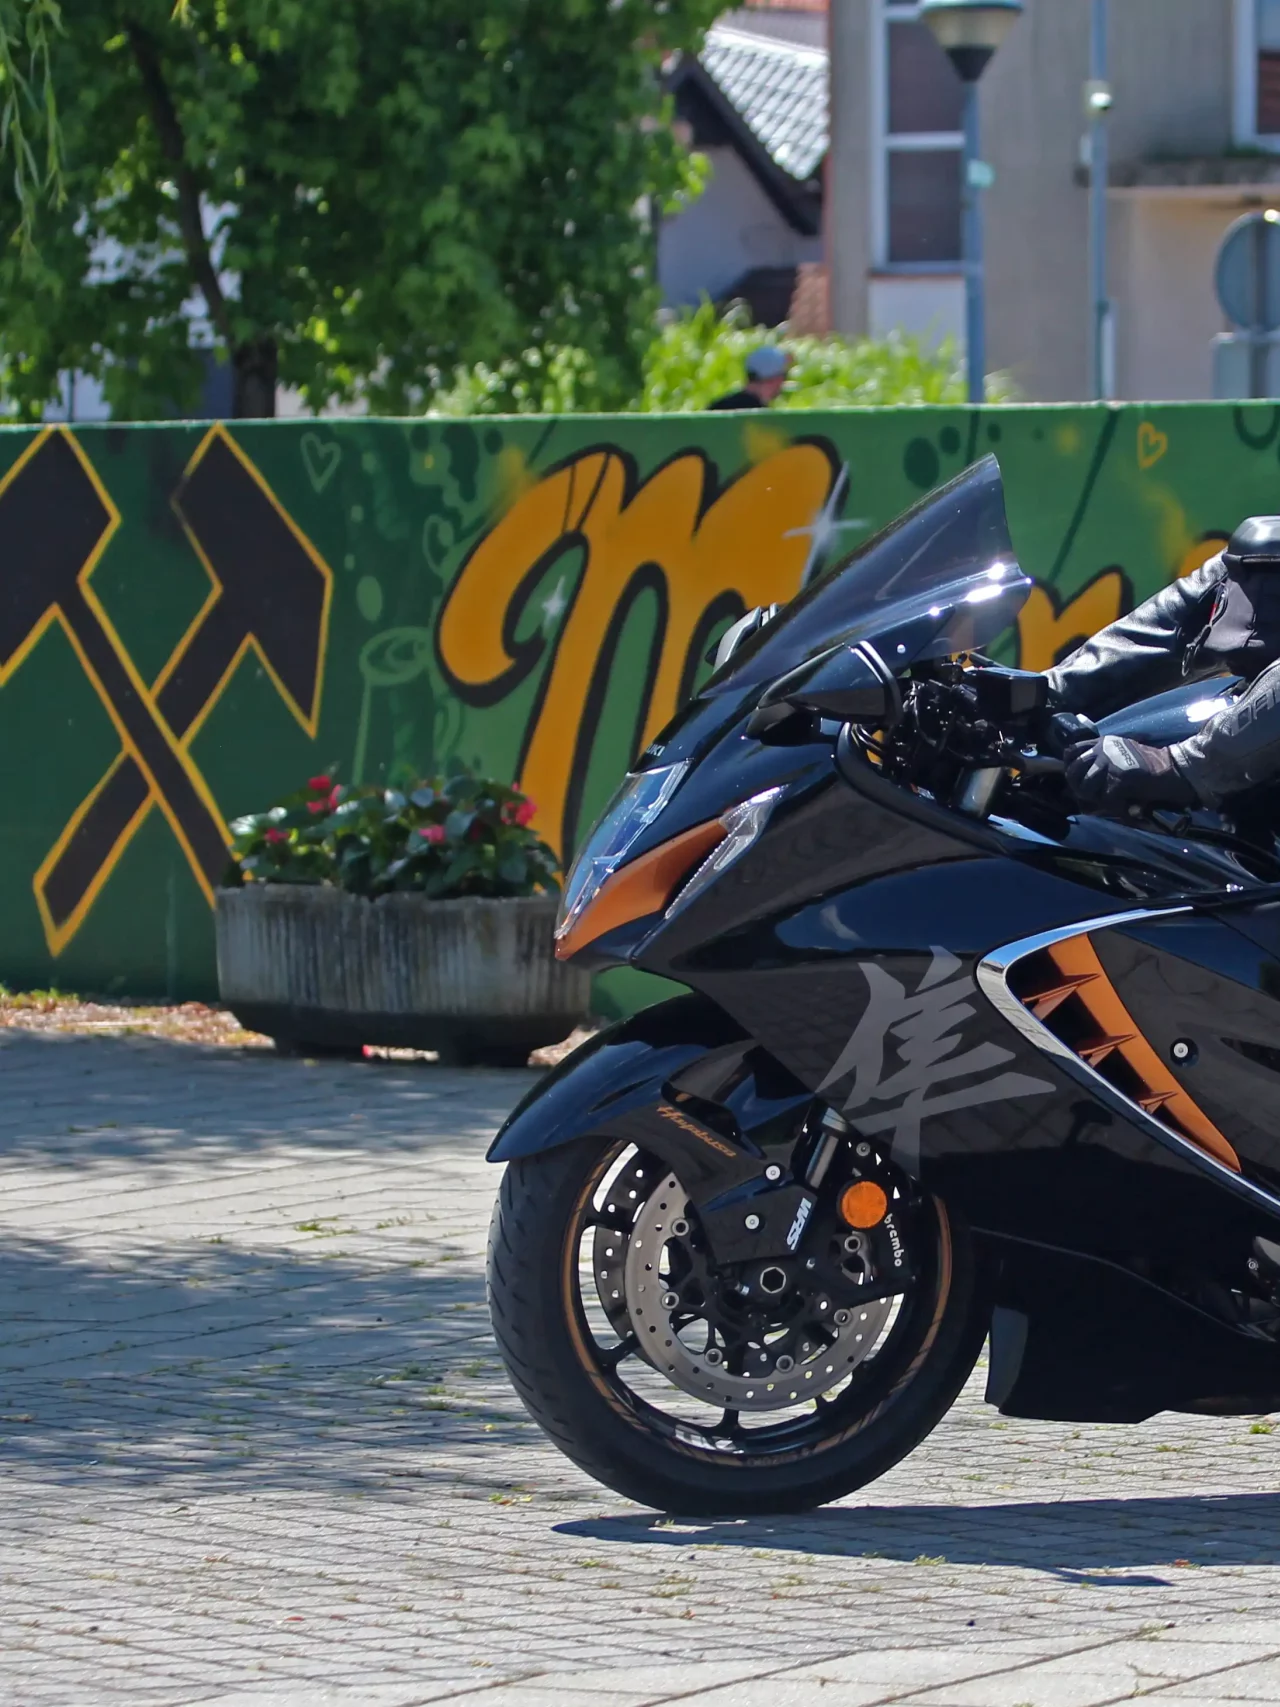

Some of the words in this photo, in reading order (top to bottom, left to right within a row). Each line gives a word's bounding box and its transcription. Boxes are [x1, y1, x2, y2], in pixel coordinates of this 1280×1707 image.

[814, 945, 1057, 1182] 隼
[786, 1197, 812, 1250] WRS
[884, 1212, 903, 1268] brembo
